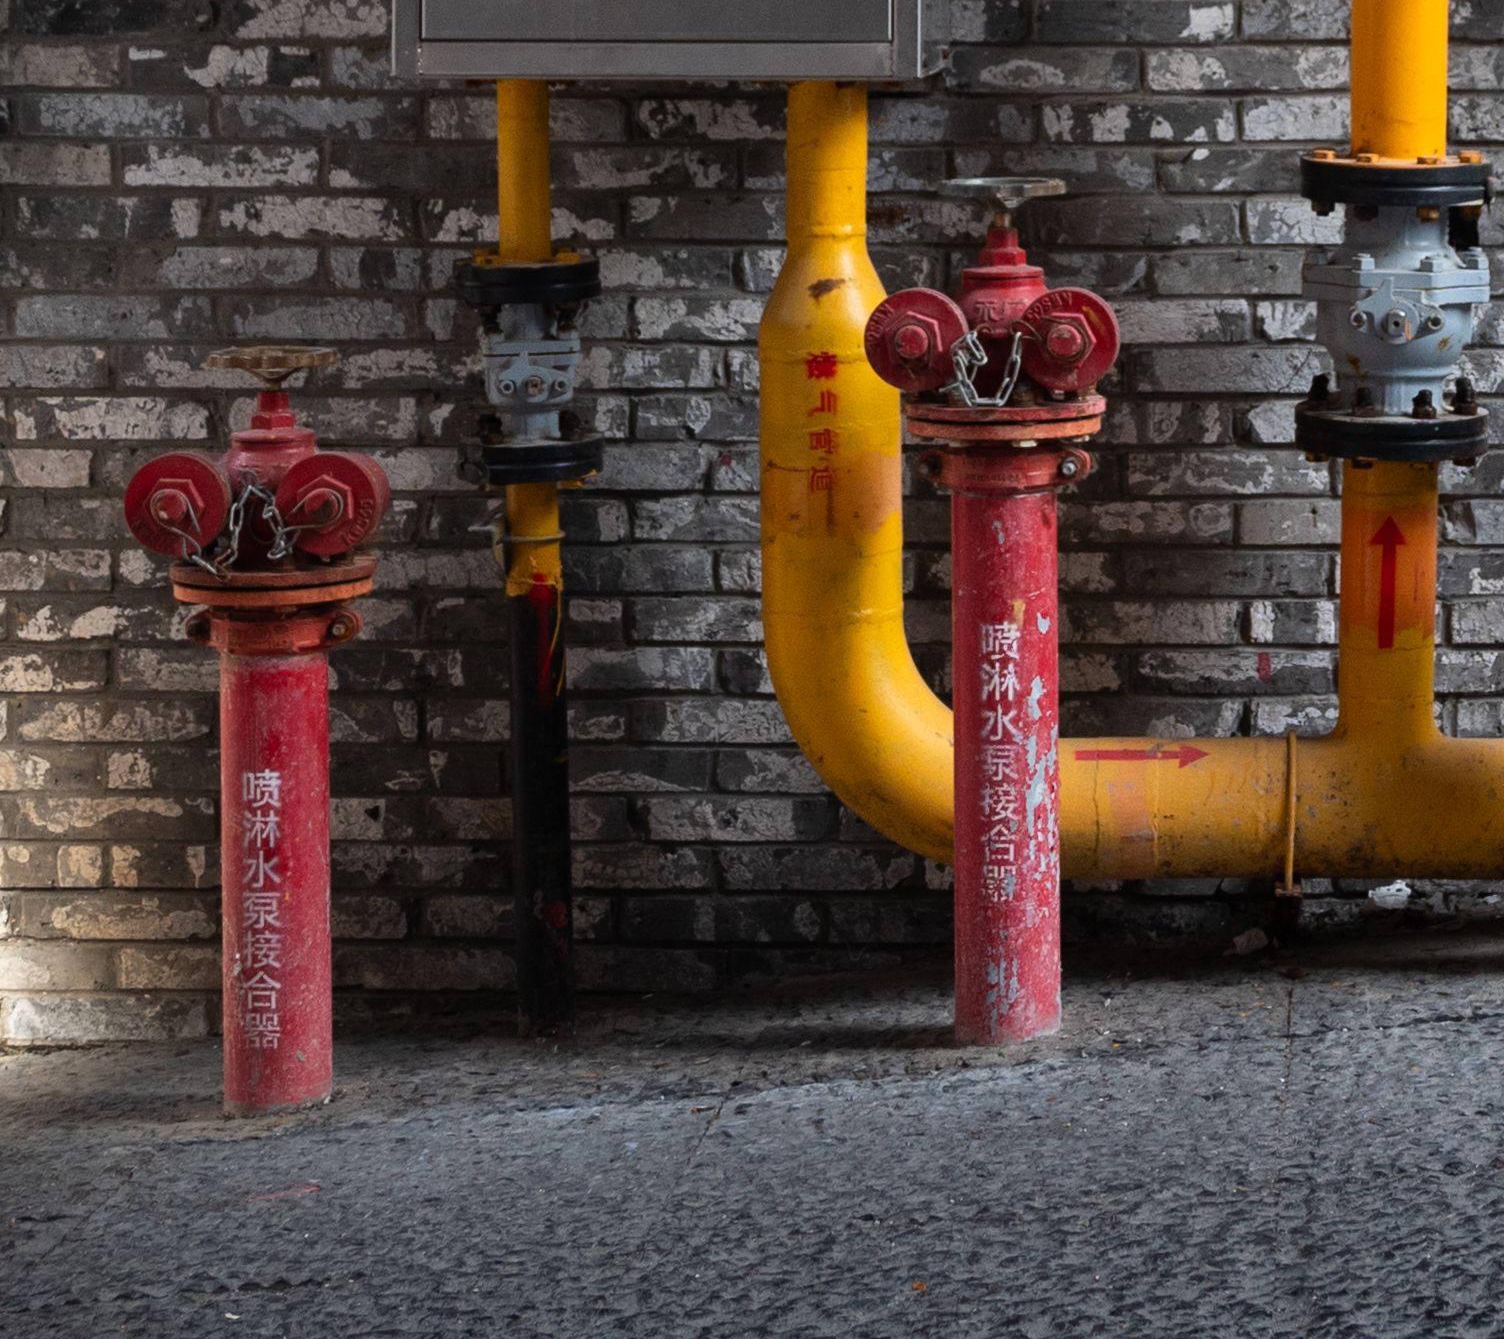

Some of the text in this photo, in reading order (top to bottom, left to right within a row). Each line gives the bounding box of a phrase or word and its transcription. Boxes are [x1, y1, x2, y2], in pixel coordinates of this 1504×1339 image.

[981, 621, 1021, 903] 喷淋水泵接合器
[242, 768, 281, 1050] 喷淋水泵接合器
